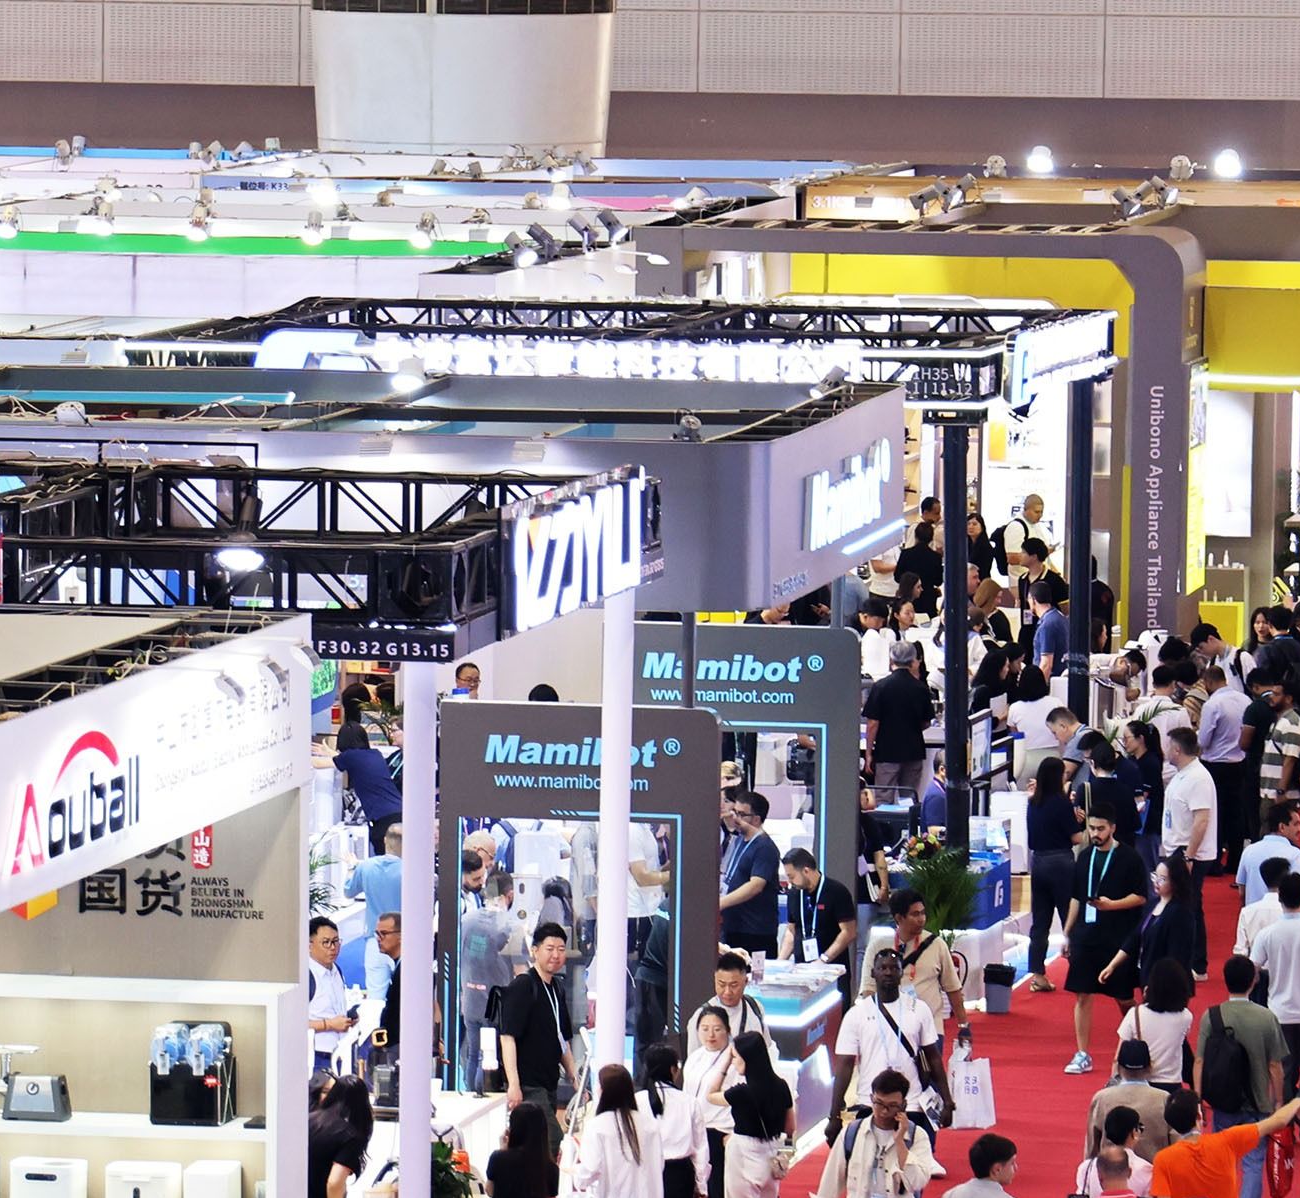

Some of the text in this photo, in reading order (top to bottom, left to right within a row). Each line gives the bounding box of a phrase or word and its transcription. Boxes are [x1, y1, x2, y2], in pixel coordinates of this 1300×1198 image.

[1145, 385, 1165, 639] Unibono Appliance Thailand
[484, 734, 657, 768] Mamiot
[191, 876, 230, 887] ALWAYS
[78, 867, 186, 917] 国货
[191, 887, 245, 898] BELIEVE IN
[191, 898, 254, 909] ZHONGSHAN
[191, 909, 264, 920] MANUFACTURE
